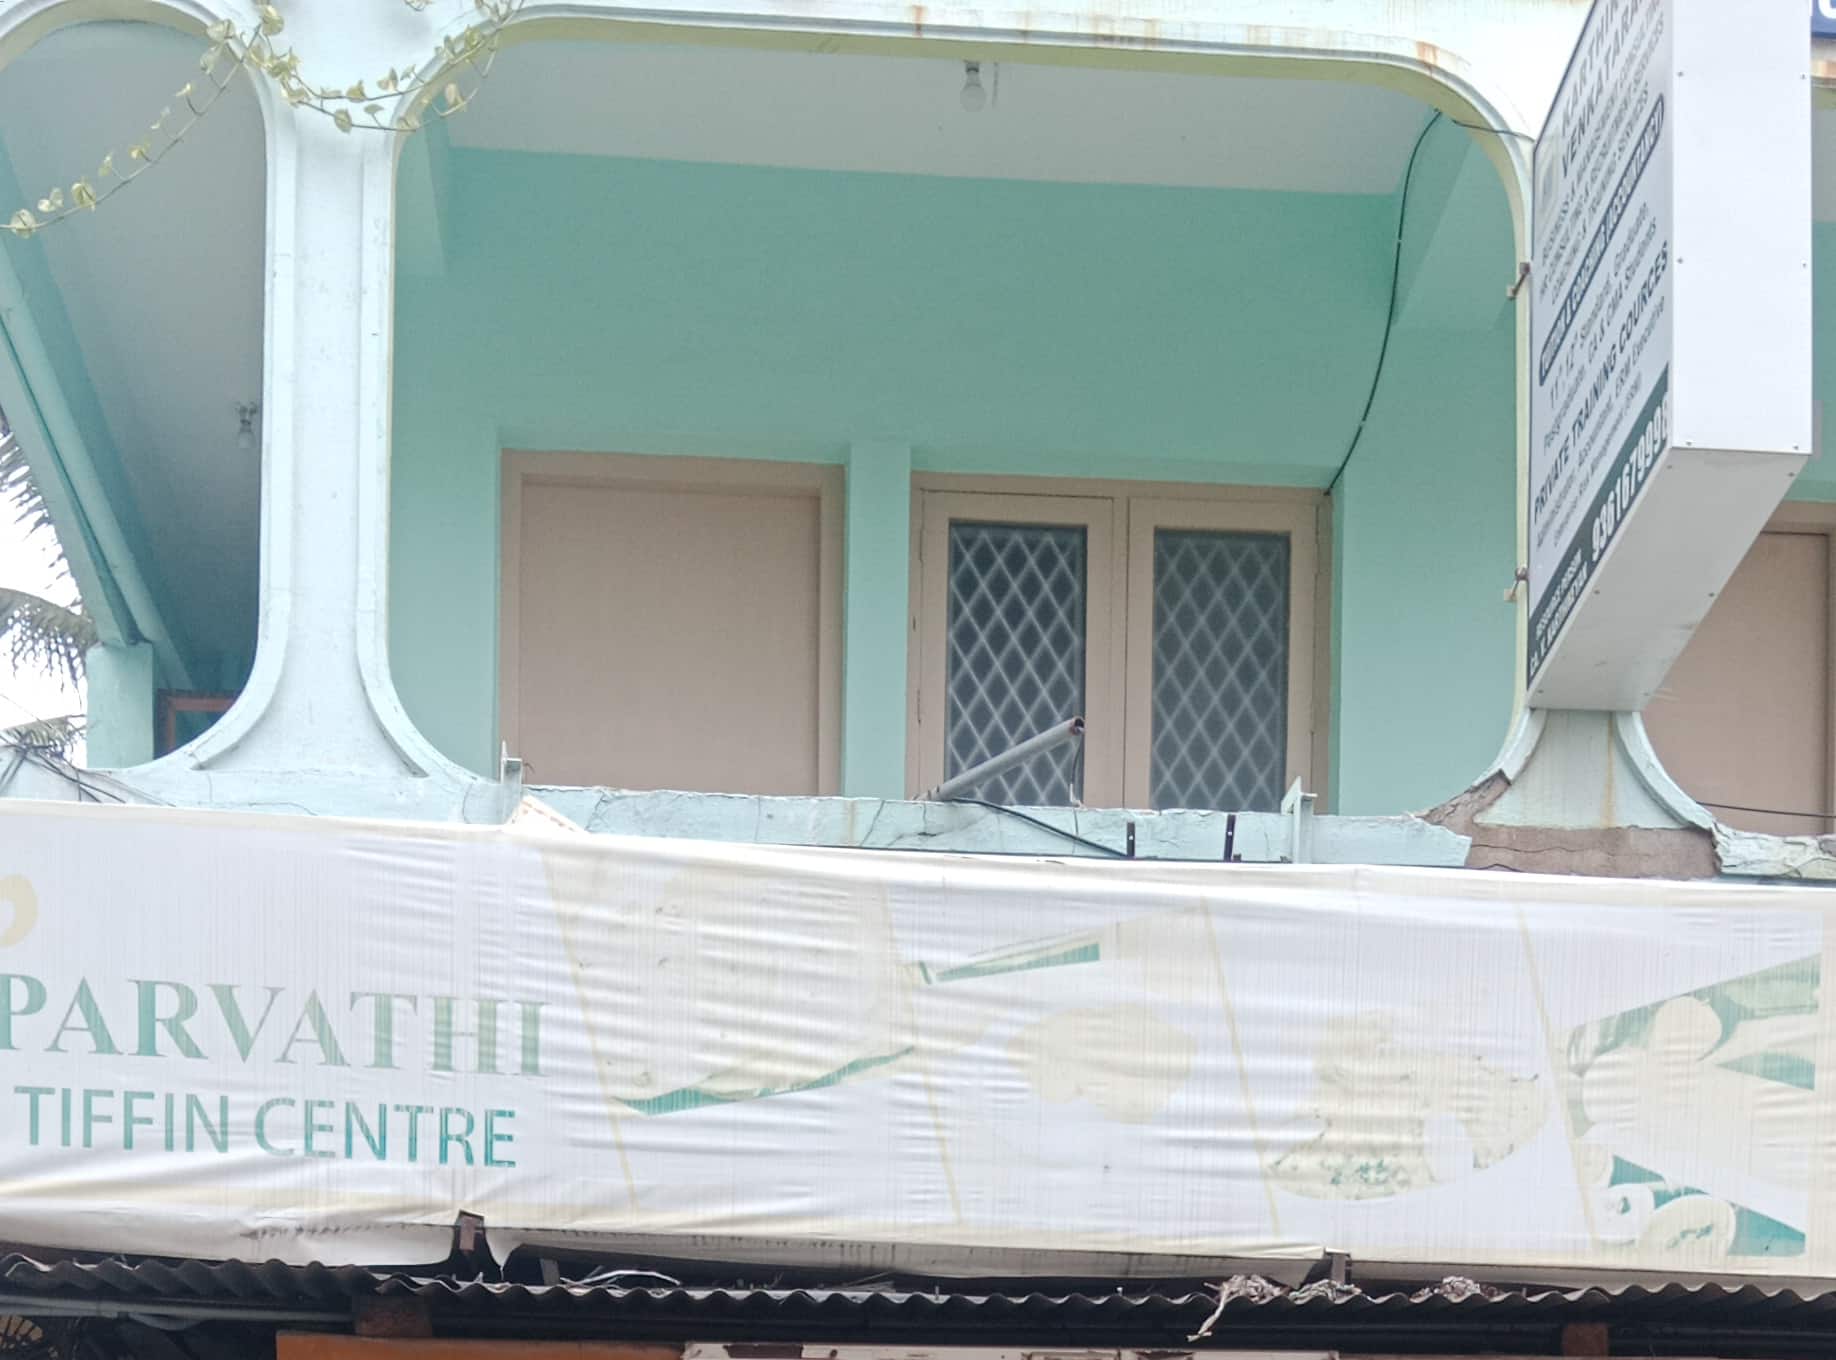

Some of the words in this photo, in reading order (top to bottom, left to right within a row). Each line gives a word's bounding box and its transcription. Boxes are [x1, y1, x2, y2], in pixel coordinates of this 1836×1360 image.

[1562, 0, 1641, 184] VENKATARA
[1534, 432, 1569, 524] PRIVATE
[1572, 339, 1616, 451] TRAINING
[1619, 237, 1667, 359] COURCES
[0, 973, 550, 1077] PARVATHI
[14, 1085, 230, 1154] TIFFIN
[255, 1097, 517, 1168] CENTRE
